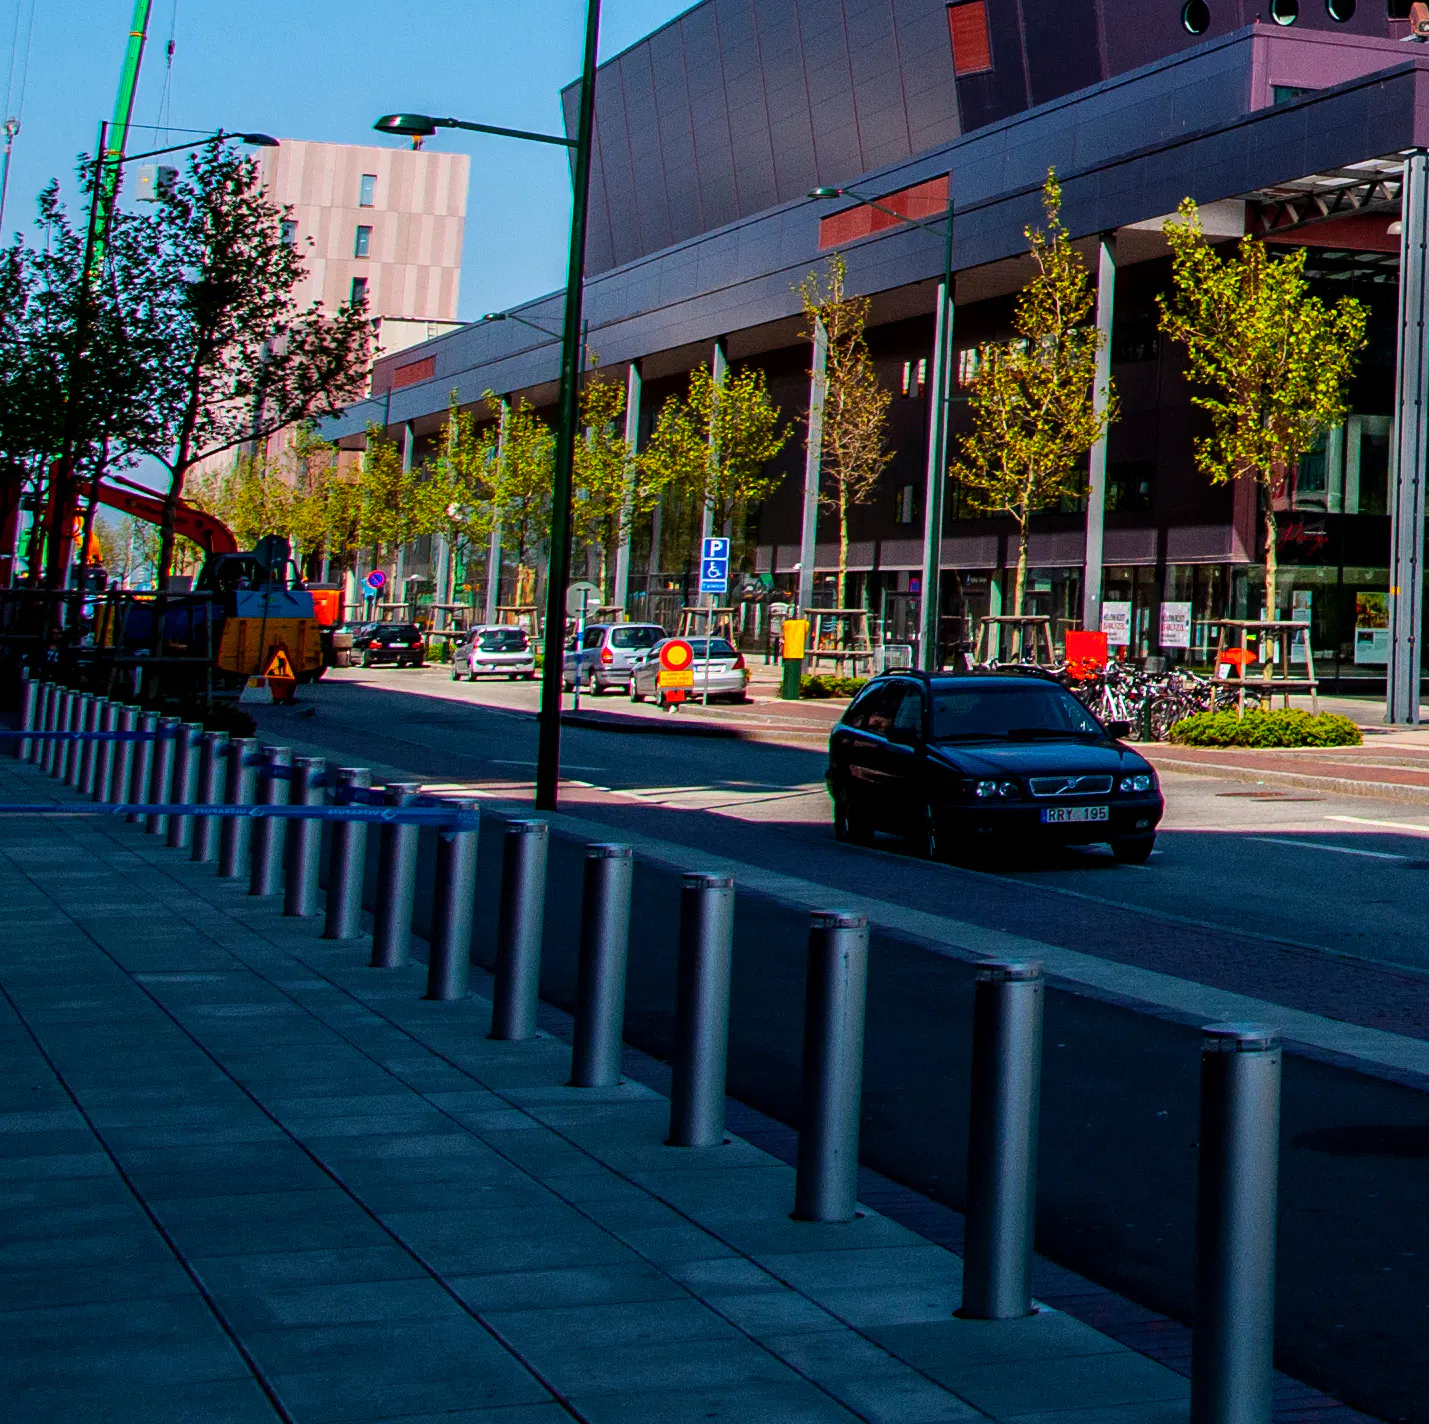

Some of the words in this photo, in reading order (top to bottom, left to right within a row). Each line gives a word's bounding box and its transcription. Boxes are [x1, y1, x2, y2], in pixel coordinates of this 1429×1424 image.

[710, 540, 723, 557] P
[1048, 808, 1072, 821] RRY
[1084, 807, 1106, 820] 195
